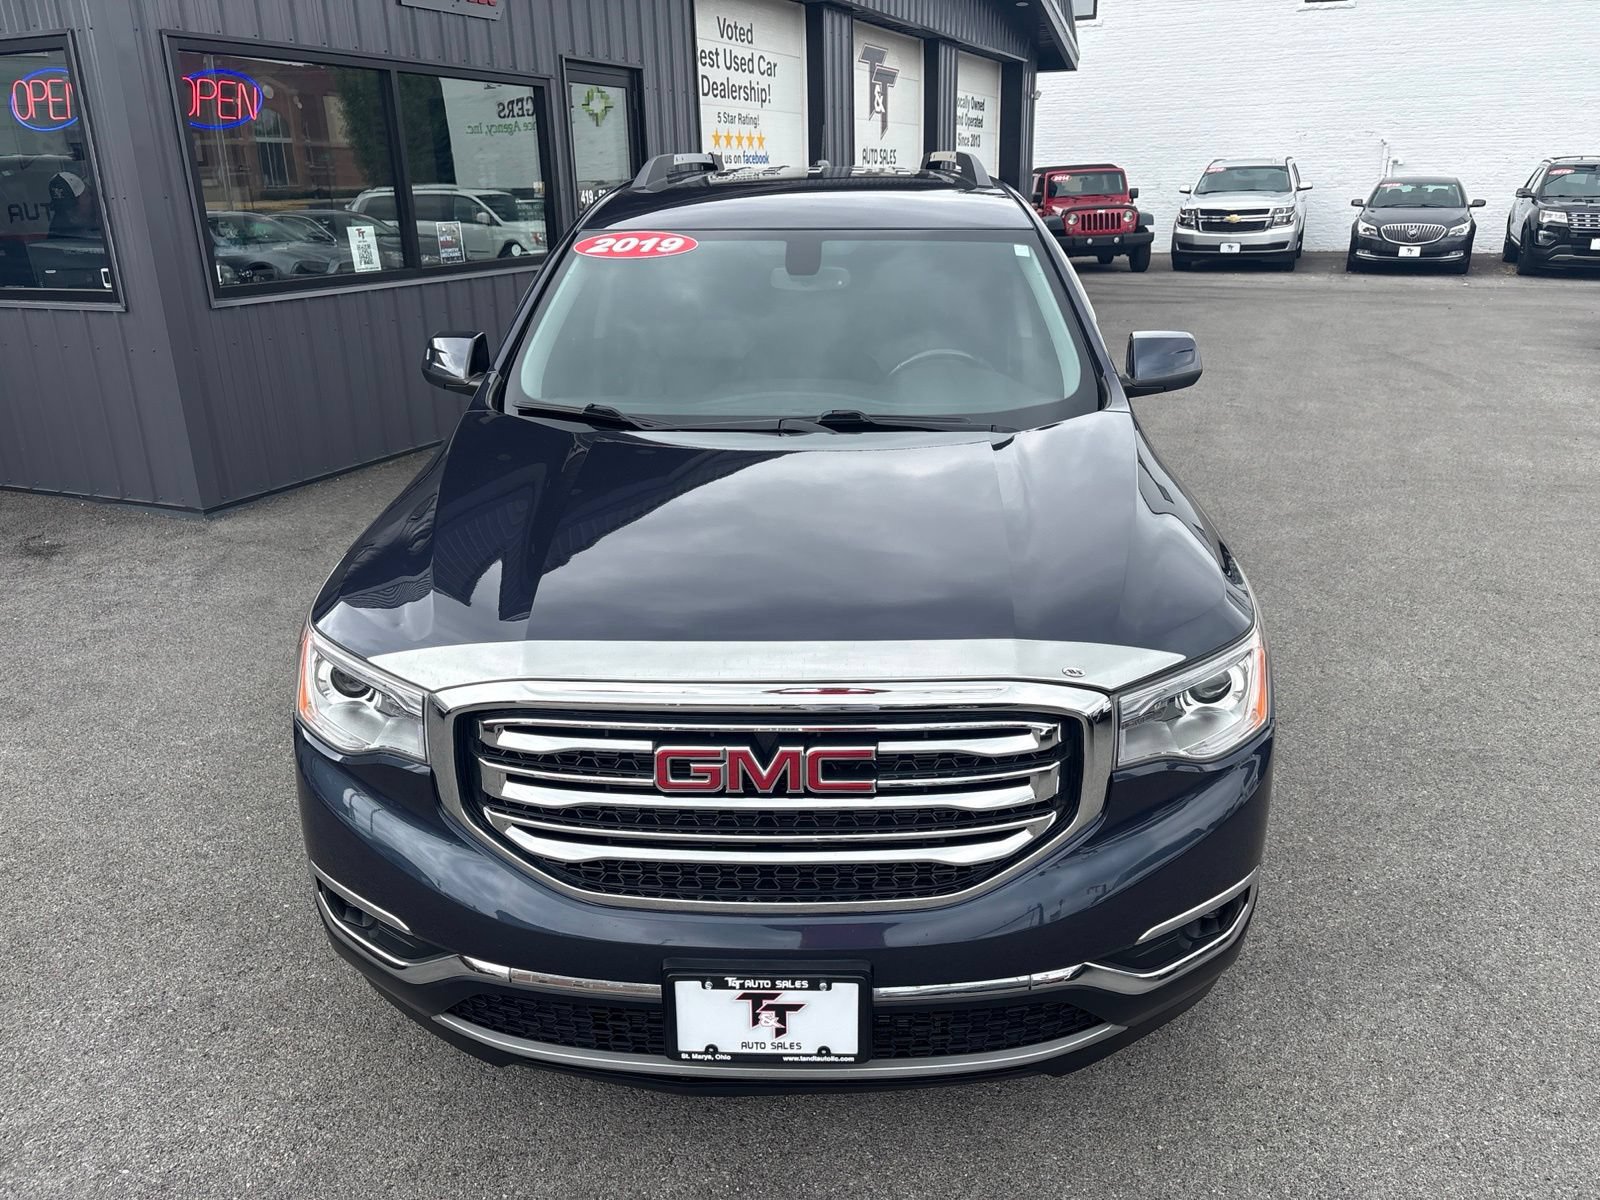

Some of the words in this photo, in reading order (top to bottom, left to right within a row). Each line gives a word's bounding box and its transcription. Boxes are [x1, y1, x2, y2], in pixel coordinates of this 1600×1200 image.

[716, 16, 753, 44] Voted
[698, 47, 720, 69] est
[723, 48, 754, 74] Used
[757, 55, 777, 77] Car
[701, 74, 771, 108] Dealership!
[717, 112, 722, 123] 5
[723, 112, 736, 125] Star
[738, 113, 760, 129] Rating!
[724, 154, 732, 164] us
[733, 154, 741, 164] on
[742, 150, 769, 164] facebook
[862, 147, 878, 165] AUTO
[879, 149, 897, 165] SALES
[8, 202, 53, 224] AUT
[585, 237, 684, 253] 2019
[654, 745, 877, 794] GMC
[744, 979, 771, 988] AUTO
[775, 980, 809, 989] SALES
[741, 1041, 766, 1050] AUTO
[770, 1041, 802, 1050] SALES
[692, 1053, 714, 1061] Marys,
[715, 1053, 732, 1061] Ohio
